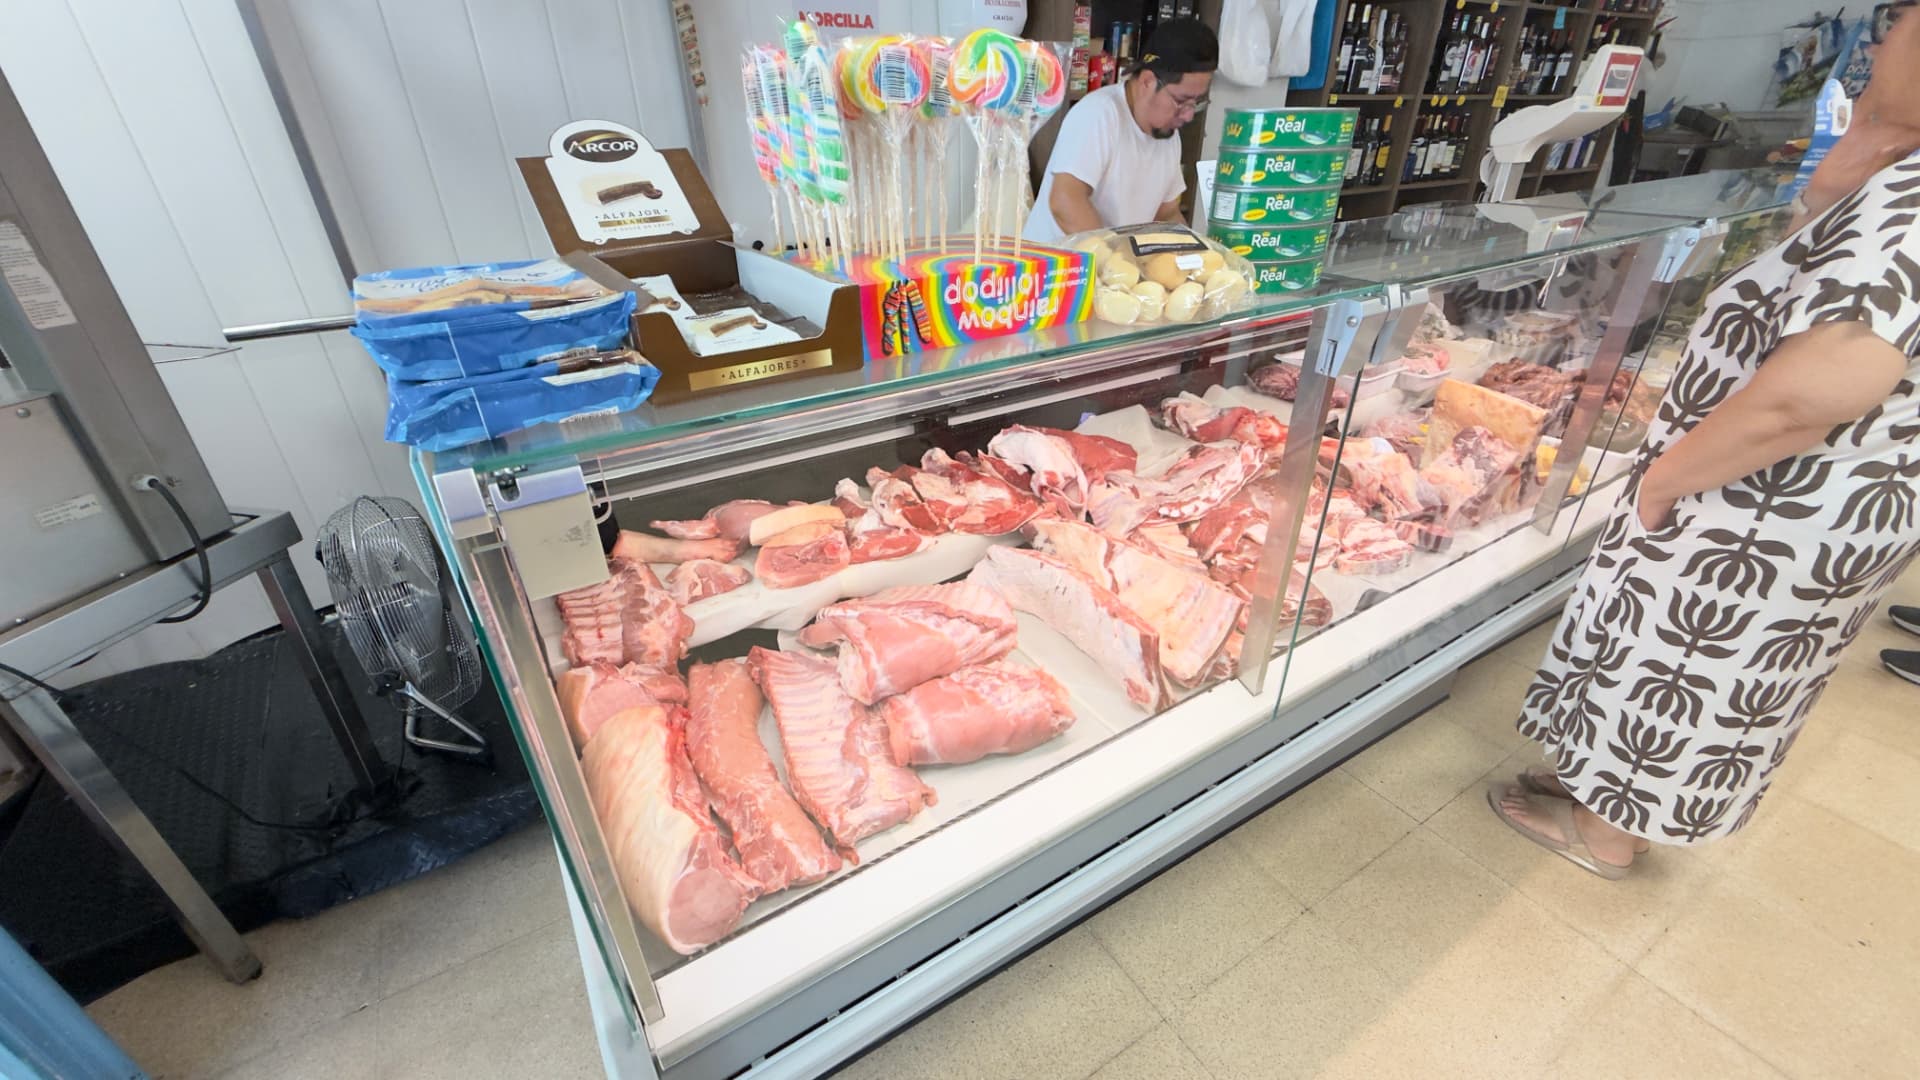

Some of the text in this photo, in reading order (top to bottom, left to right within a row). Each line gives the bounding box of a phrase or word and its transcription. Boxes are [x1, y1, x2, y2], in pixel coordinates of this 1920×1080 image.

[1274, 117, 1306, 133] Real
[568, 140, 637, 153] ARCOR
[1265, 158, 1296, 173] Real
[1265, 195, 1295, 211] Real
[603, 209, 661, 219] ALFAJOR
[1251, 233, 1281, 248] Real
[1259, 268, 1287, 283] Real
[944, 271, 1040, 304] lollipop
[958, 296, 1059, 331] rainbow
[728, 359, 799, 380] ALFAJORES
